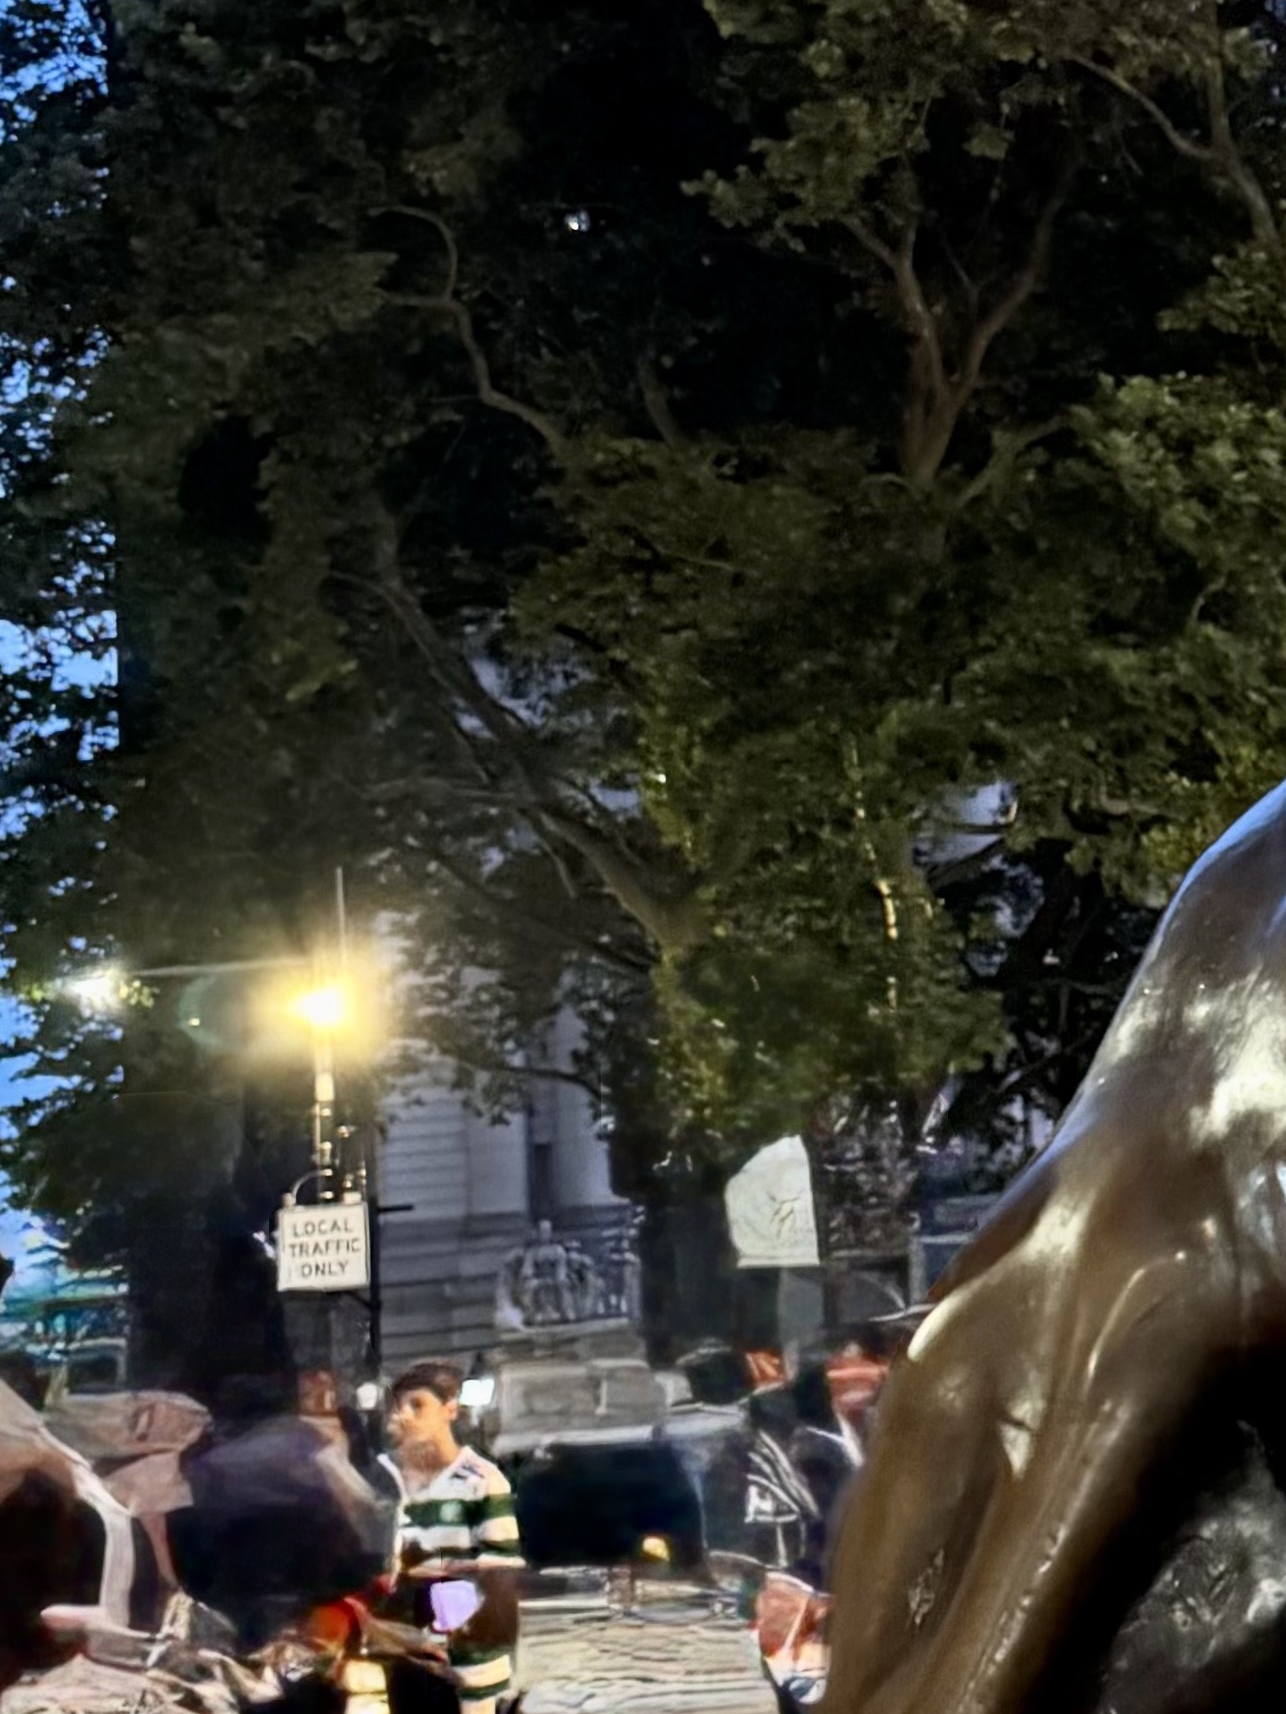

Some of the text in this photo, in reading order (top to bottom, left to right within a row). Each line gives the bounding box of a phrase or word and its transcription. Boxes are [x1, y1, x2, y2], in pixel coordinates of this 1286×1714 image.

[292, 1218, 353, 1238] LOCAL
[289, 1237, 361, 1258] TRAFFIC
[301, 1260, 349, 1279] ONLY
